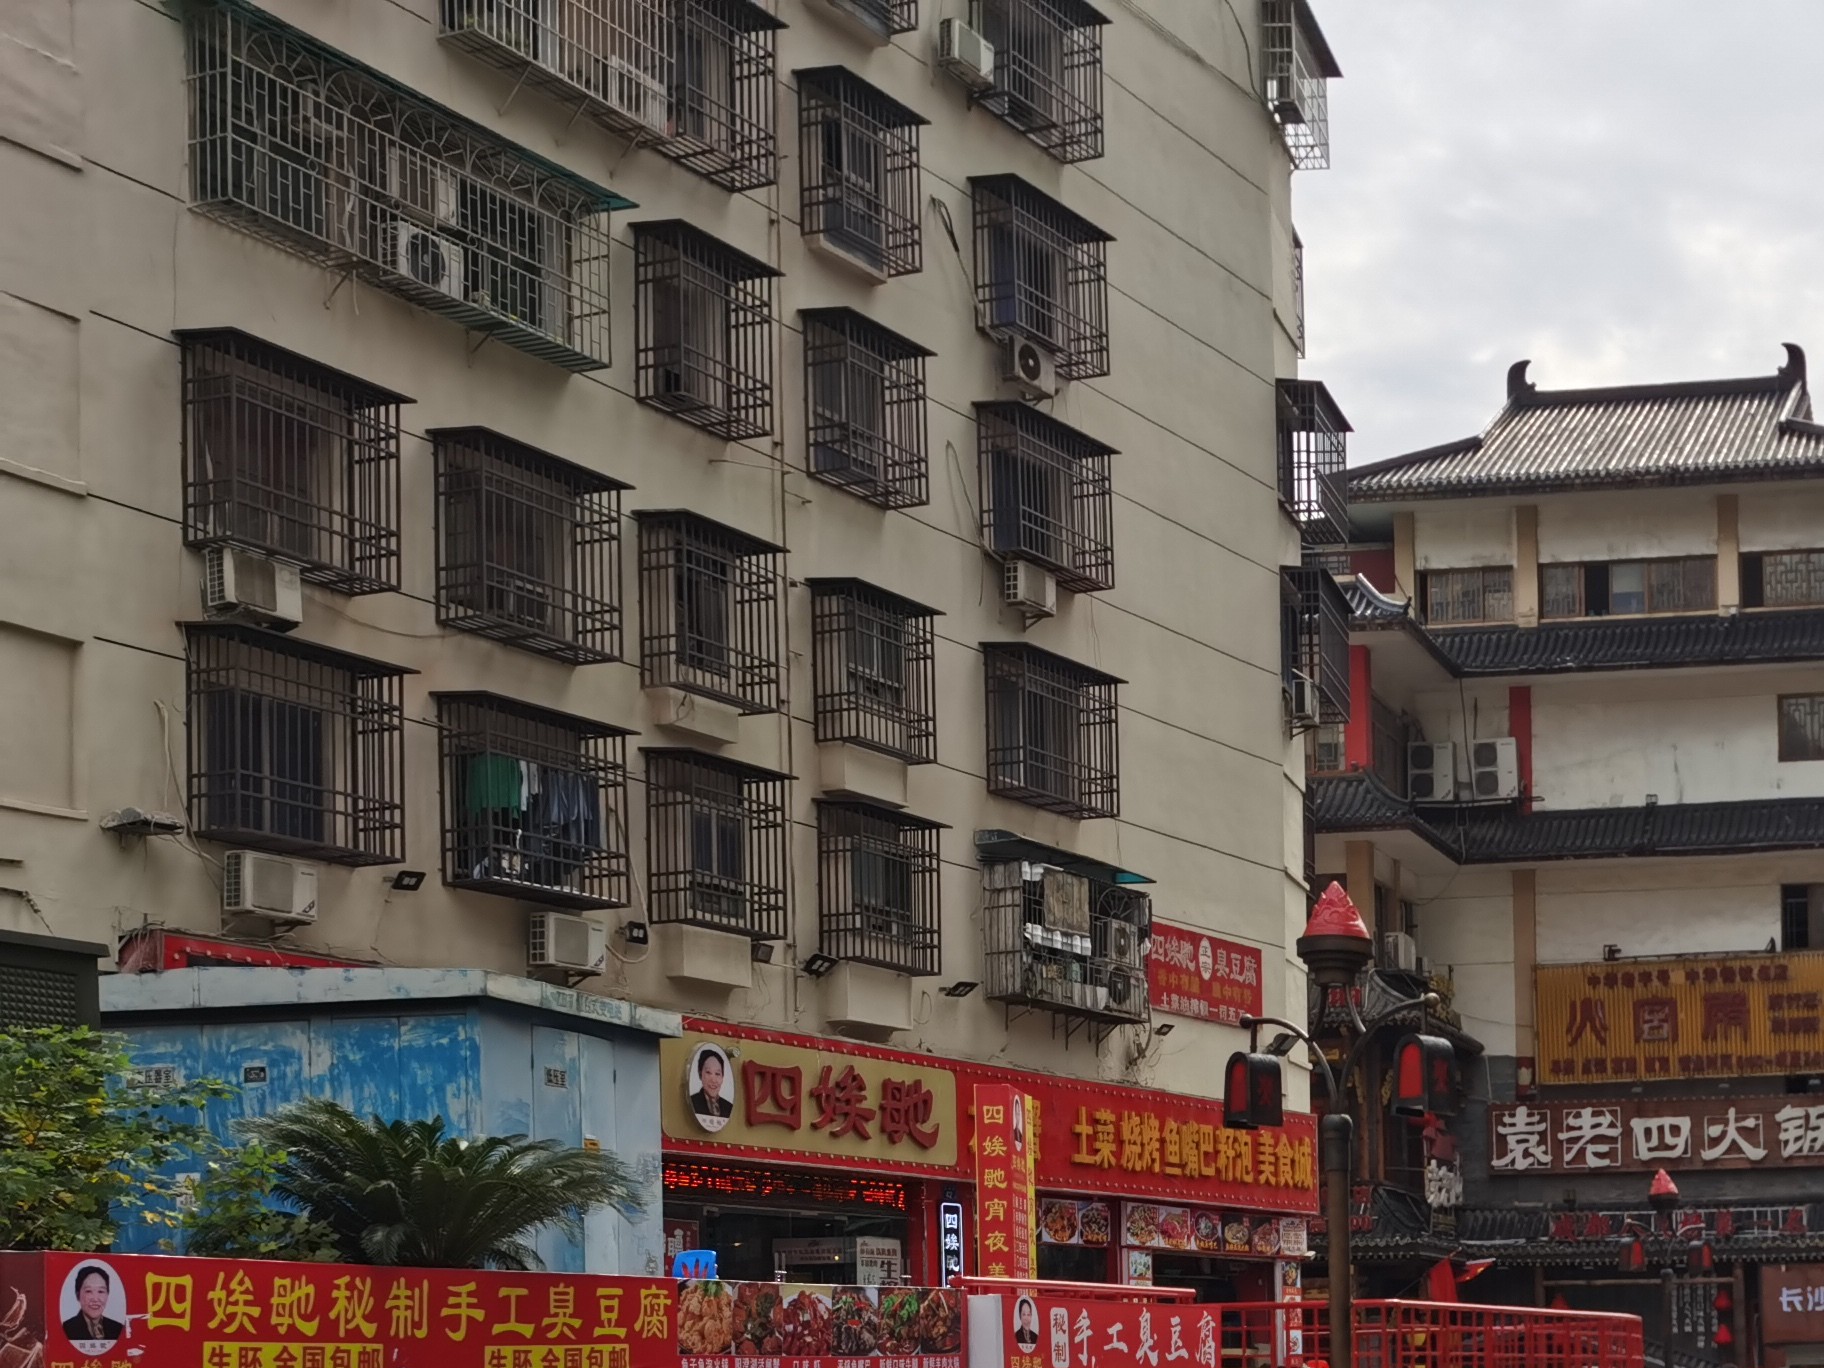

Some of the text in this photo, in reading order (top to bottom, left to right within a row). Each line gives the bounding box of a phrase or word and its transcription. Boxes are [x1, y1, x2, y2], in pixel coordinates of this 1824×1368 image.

[1215, 947, 1258, 987] 臭豆腐
[1071, 1106, 1116, 1169] 土菜
[1257, 1131, 1313, 1190] 美食城
[1052, 1312, 1068, 1363] 秘制
[1073, 1307, 1216, 1368] 手工臭豆腐
